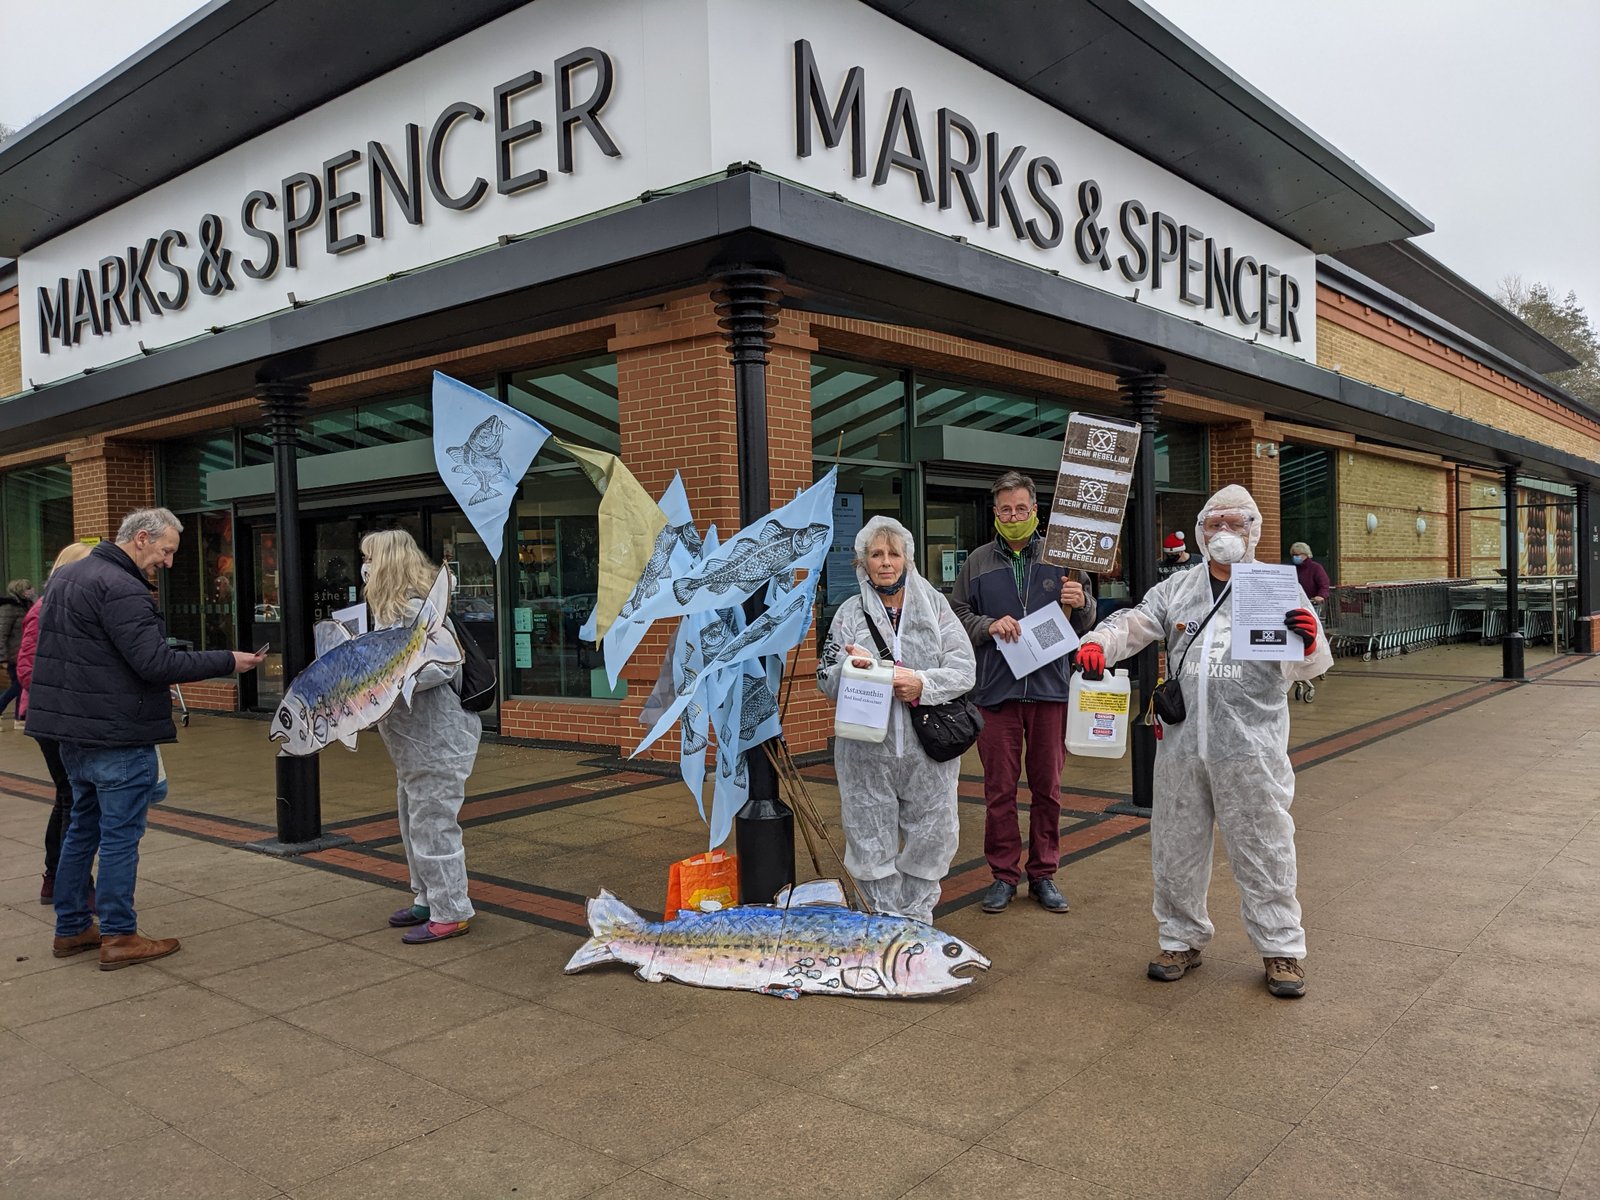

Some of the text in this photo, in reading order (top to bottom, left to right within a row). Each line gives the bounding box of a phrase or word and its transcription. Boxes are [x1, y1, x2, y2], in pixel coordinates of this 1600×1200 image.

[794, 38, 1301, 342] MARKS & SPENCER
[37, 46, 621, 354] MARKS & SPENCER
[1068, 447, 1130, 464] OCEAN REBELLION
[1058, 498, 1119, 515] OCEAN REBELLION
[1048, 549, 1109, 565] OCEAN REBELLION
[1186, 661, 1242, 679] MAXISM
[844, 686, 884, 698] Astaxanthin
